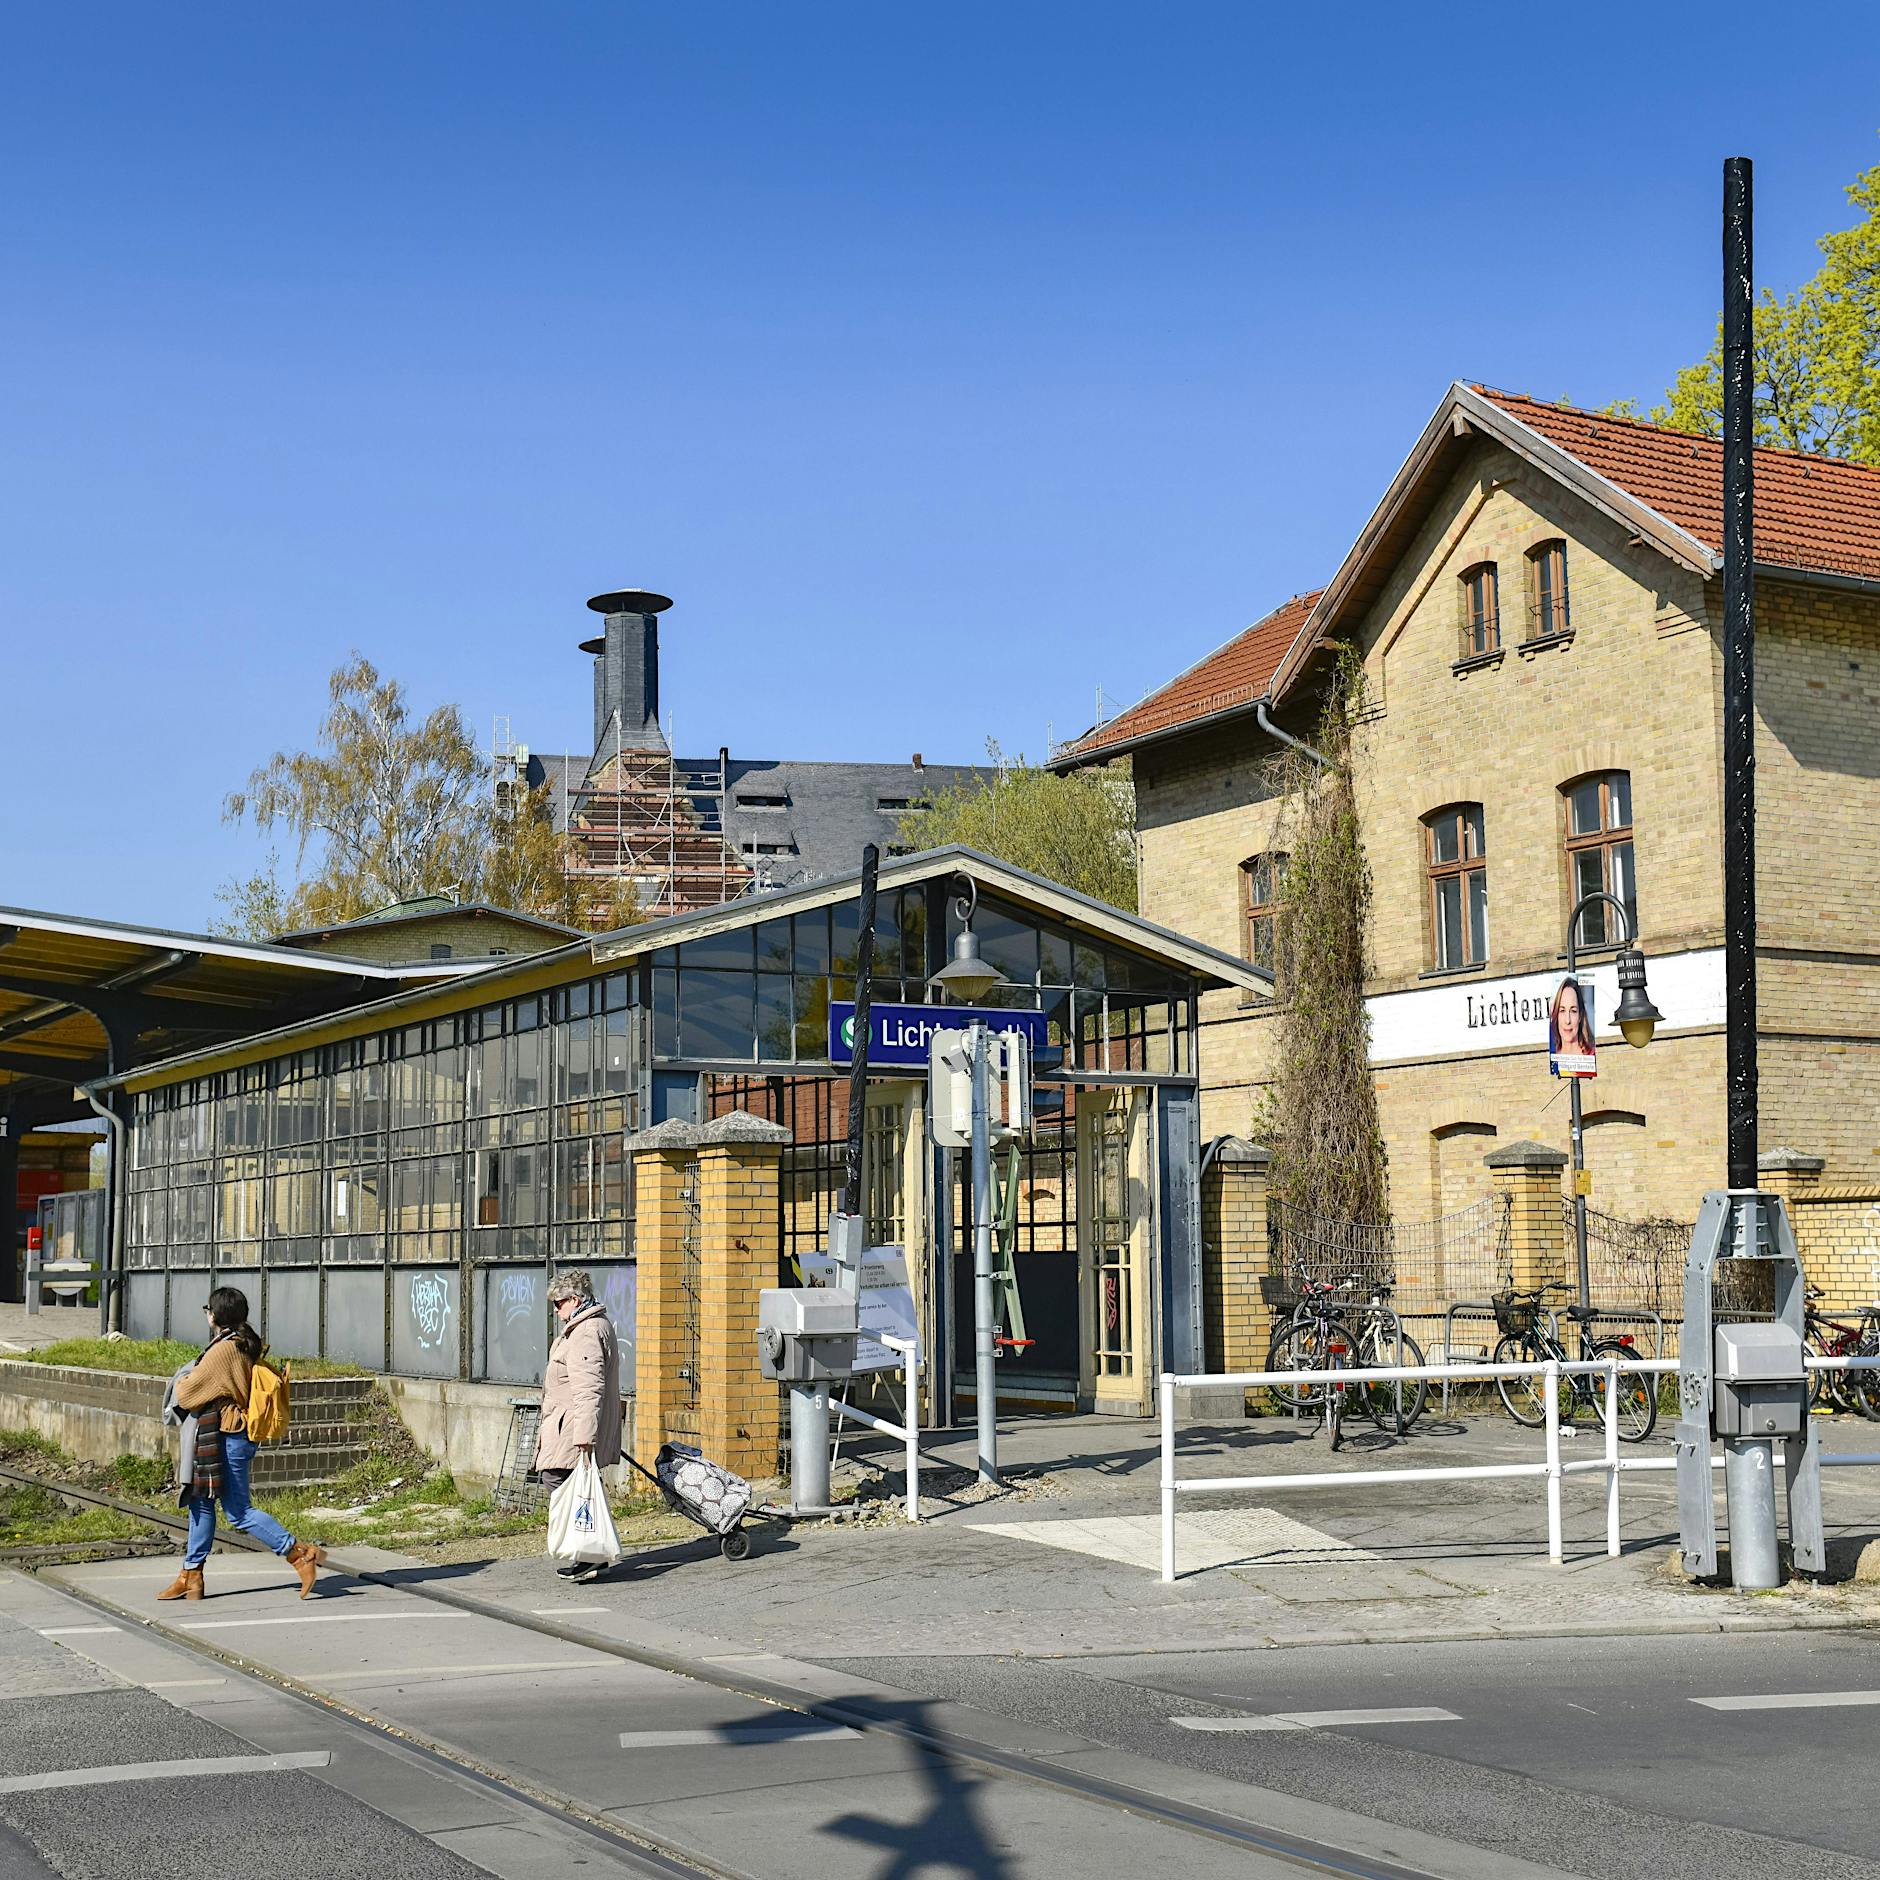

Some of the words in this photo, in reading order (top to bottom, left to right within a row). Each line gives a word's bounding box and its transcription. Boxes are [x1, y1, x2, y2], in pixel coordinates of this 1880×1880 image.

[1467, 990, 1551, 1028] Lichtenr
[815, 1394, 822, 1410] 5
[1755, 1451, 1765, 1470] 2
